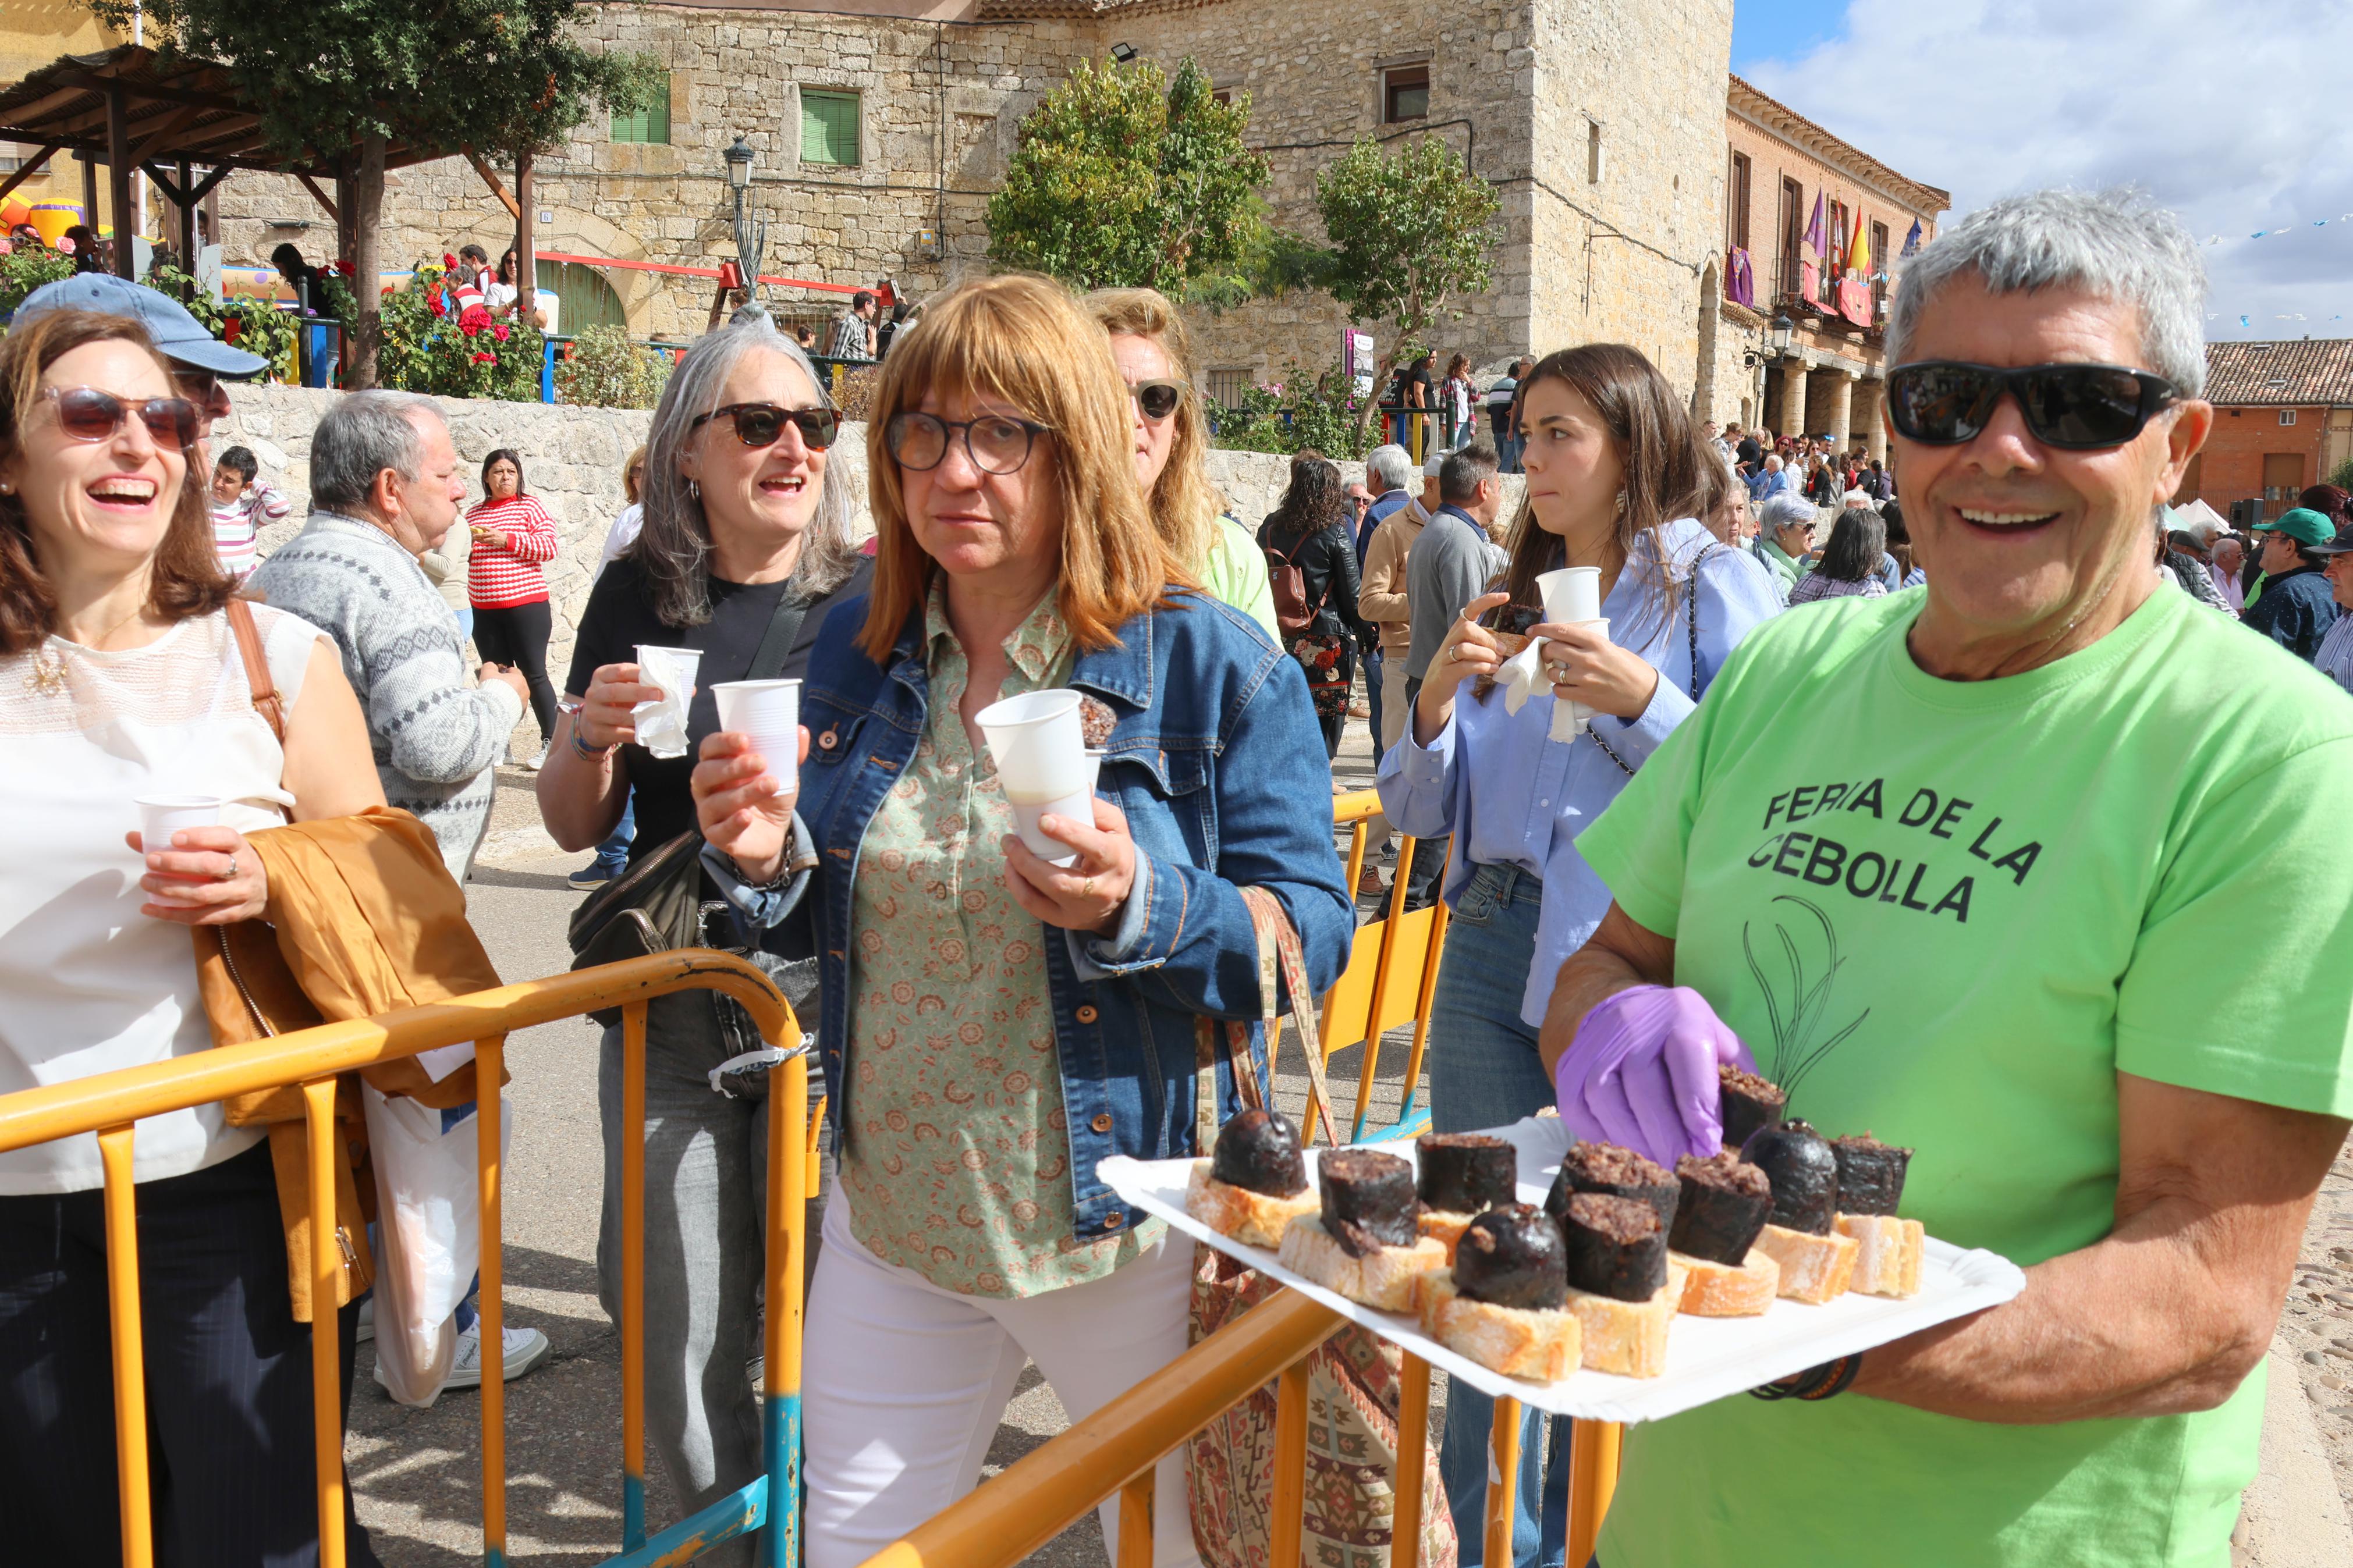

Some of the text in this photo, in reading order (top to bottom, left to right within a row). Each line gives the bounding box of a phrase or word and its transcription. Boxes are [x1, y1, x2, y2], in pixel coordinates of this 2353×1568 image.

[544, 213, 549, 221] 6
[1747, 831, 1975, 923] CEBOLLA
[1762, 778, 2043, 886] FERIA DE LA
